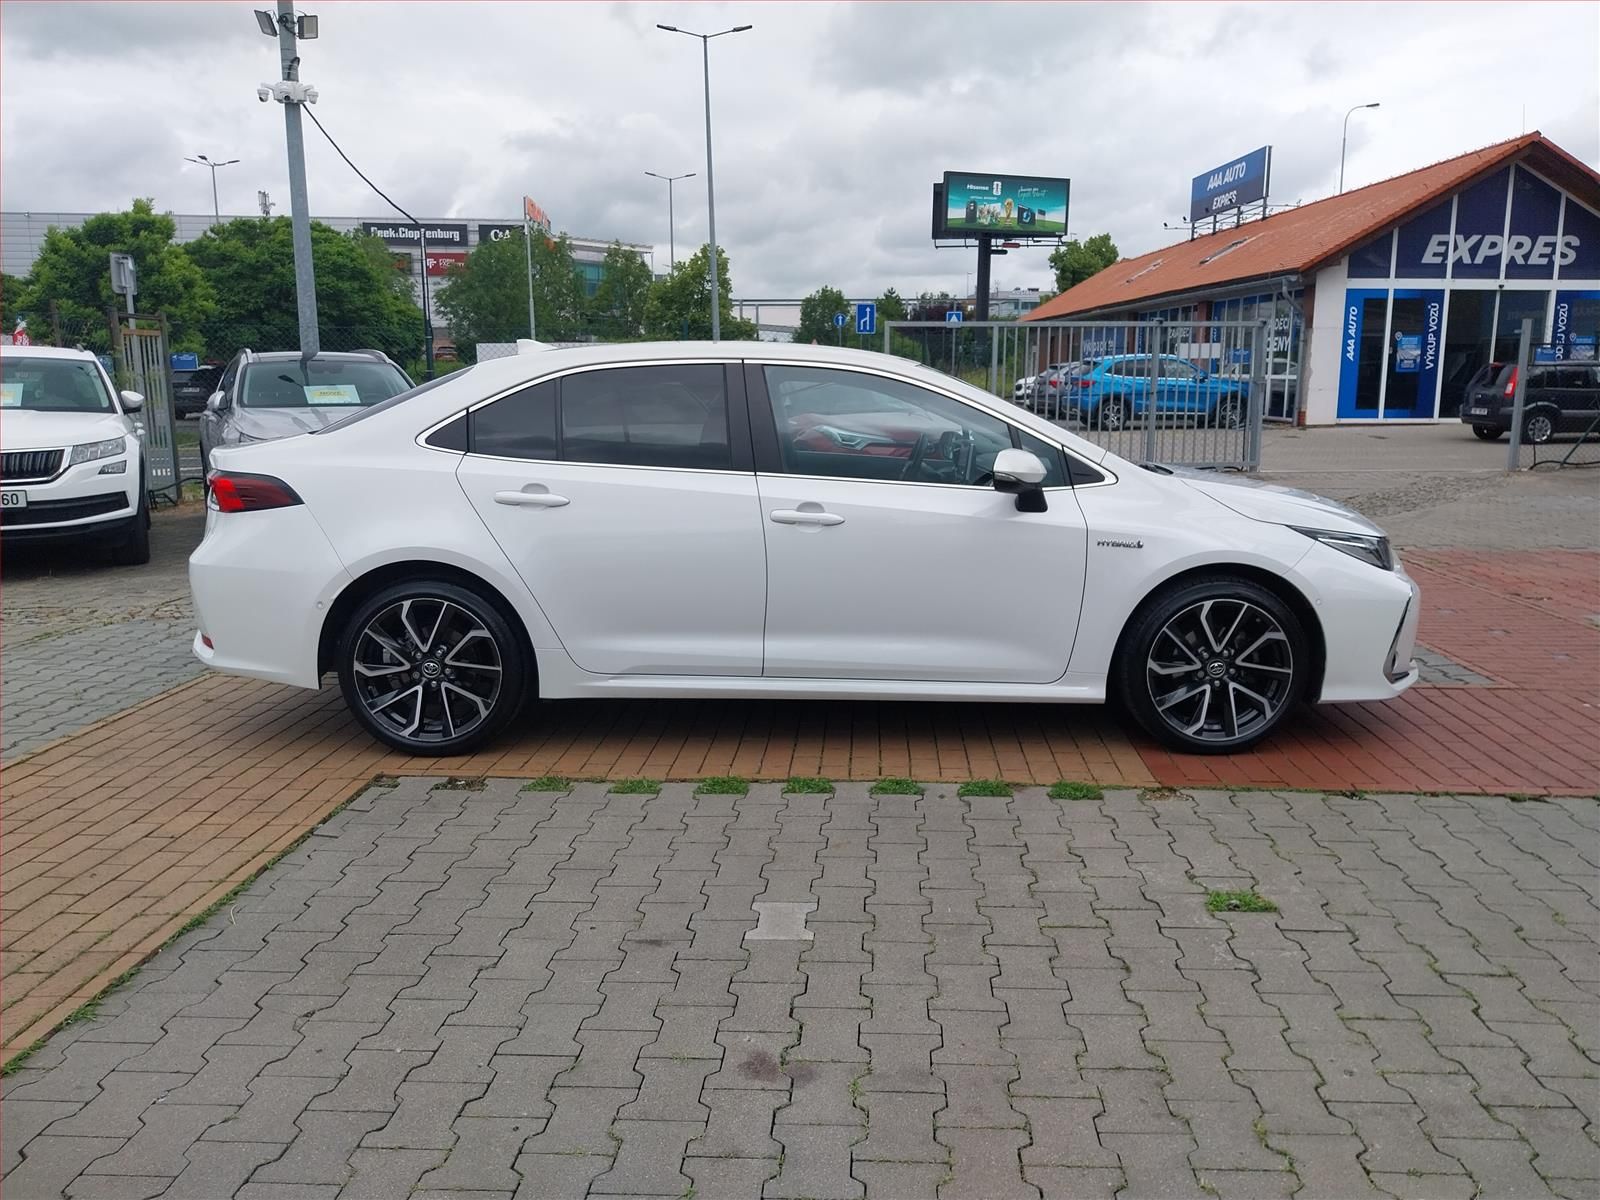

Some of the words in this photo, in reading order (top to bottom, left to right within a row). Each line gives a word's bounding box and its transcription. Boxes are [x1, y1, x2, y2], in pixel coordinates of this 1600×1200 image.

[1206, 171, 1223, 192] AAA
[1222, 160, 1247, 184] AUTO
[1211, 189, 1238, 211] EXPRES
[490, 228, 511, 242] C&A
[1420, 232, 1581, 267] EXPRES
[1347, 305, 1358, 339] AUTO
[1427, 302, 1440, 333] VOZŮ
[1556, 302, 1569, 333] VOZŮ
[1346, 338, 1356, 362] AAA
[1423, 332, 1437, 370] VÝKUP
[1, 493, 19, 506] 60
[1097, 541, 1136, 549] HYBRID
